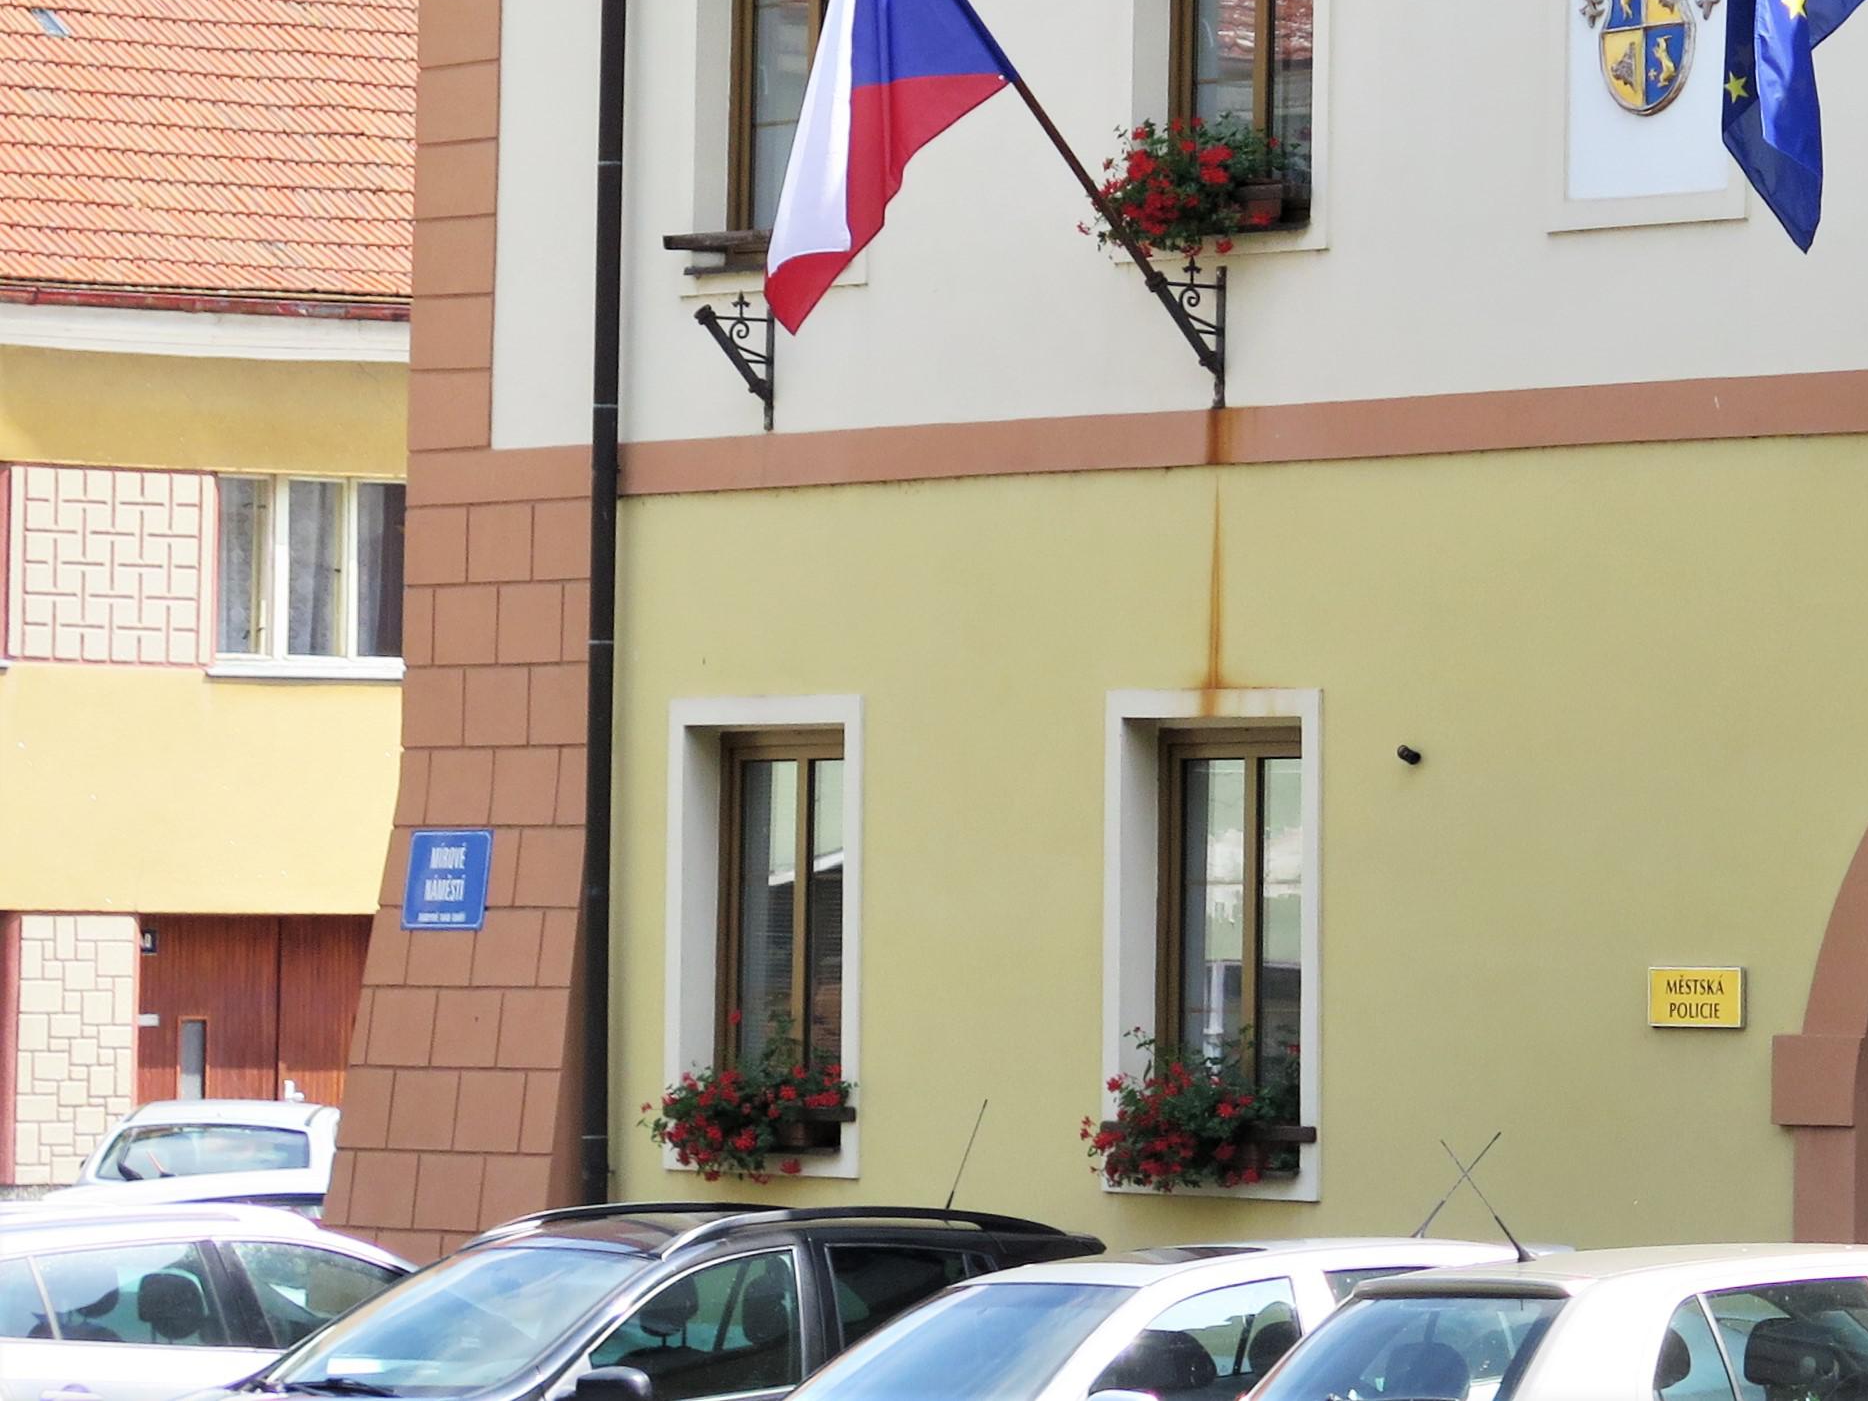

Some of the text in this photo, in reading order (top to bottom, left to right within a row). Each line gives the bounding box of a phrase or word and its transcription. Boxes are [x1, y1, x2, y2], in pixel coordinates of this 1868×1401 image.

[423, 874, 466, 902] NÁMĚSTÍ
[1665, 974, 1725, 995] MĚSTSKÁ
[1669, 1002, 1721, 1019] POLICIE
